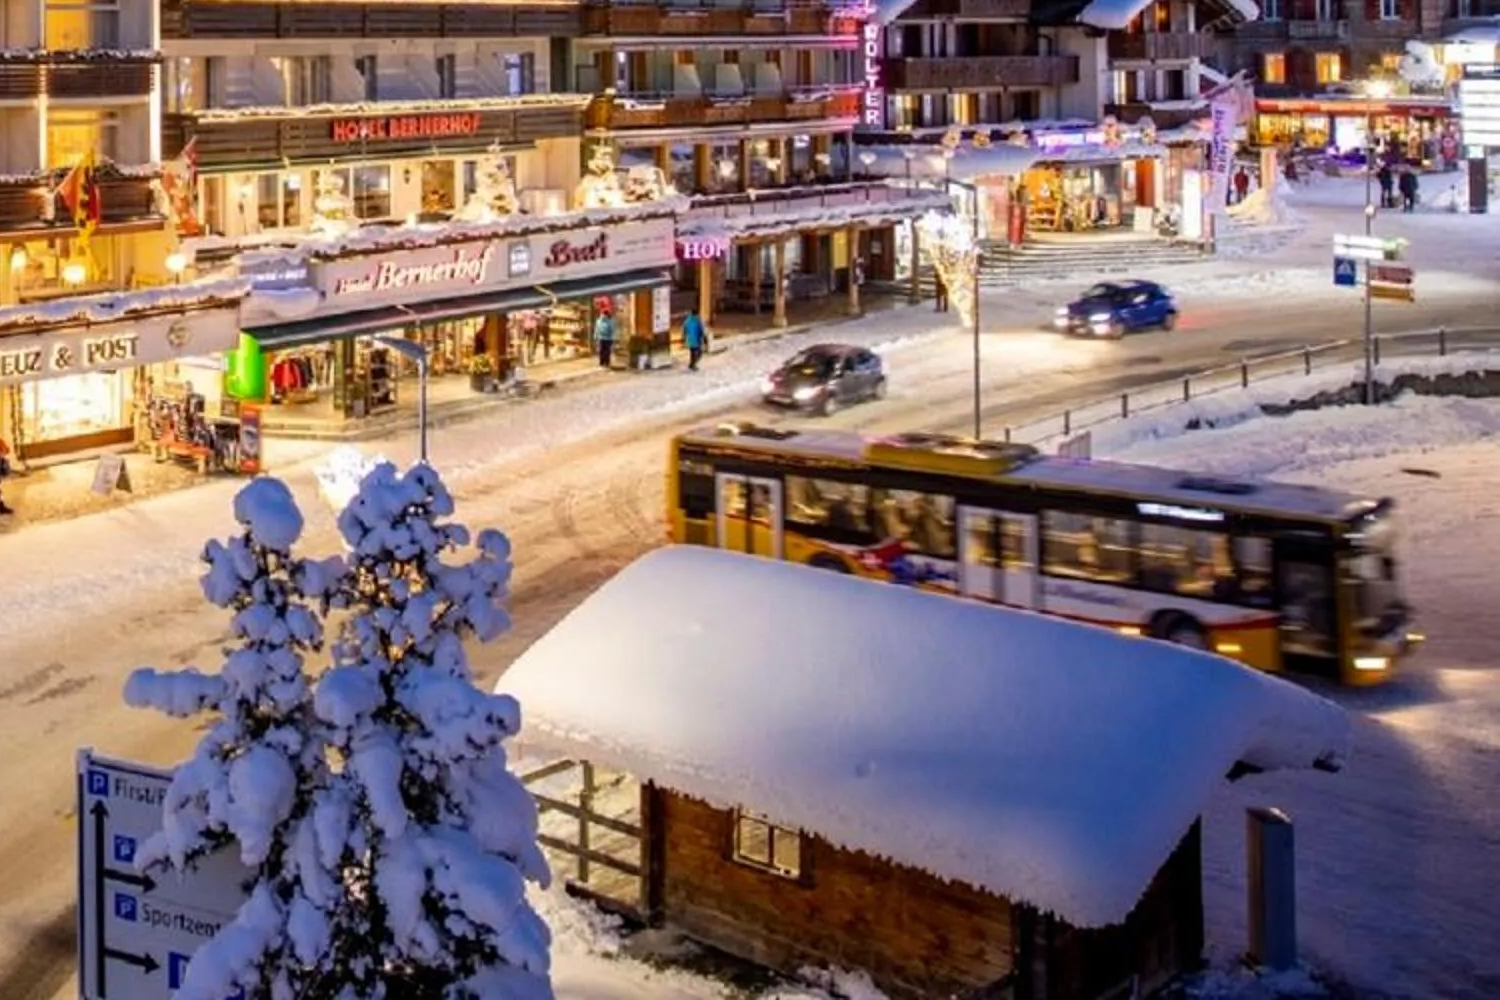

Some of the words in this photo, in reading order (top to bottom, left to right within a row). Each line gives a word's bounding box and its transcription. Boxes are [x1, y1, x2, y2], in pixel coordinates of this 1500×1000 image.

[333, 117, 385, 141] HOTEL
[389, 112, 482, 137] BERNERHOF
[374, 245, 493, 290] Bernerhof
[55, 346, 73, 368] &
[86, 337, 140, 363] POST
